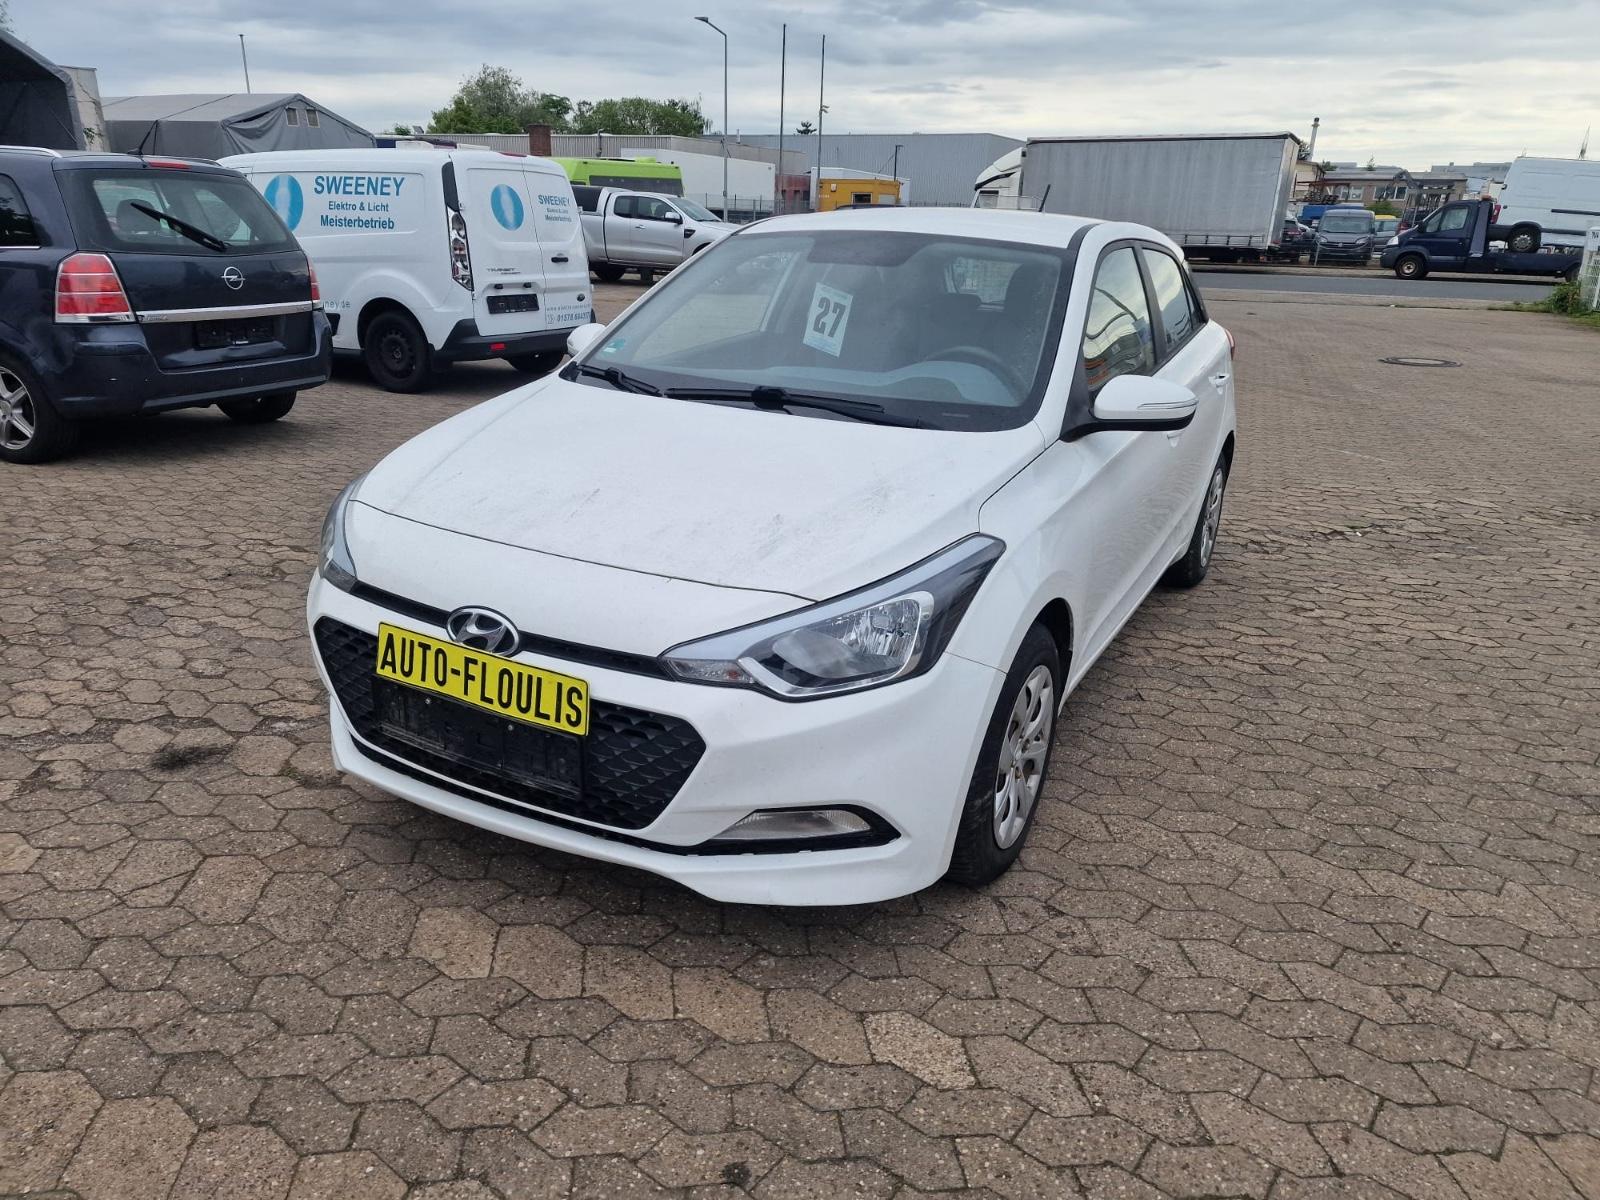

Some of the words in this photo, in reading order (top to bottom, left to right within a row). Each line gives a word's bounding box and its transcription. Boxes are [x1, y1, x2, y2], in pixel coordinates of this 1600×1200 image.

[314, 175, 405, 196] SWEENEY
[328, 200, 357, 211] Elektro
[359, 201, 365, 211] &
[368, 202, 389, 212] Licht
[537, 194, 570, 207] SWEENEY
[320, 214, 395, 230] Meisterbetrieb
[813, 296, 847, 338] 27
[380, 632, 583, 728] AUTO-FLOULIS
